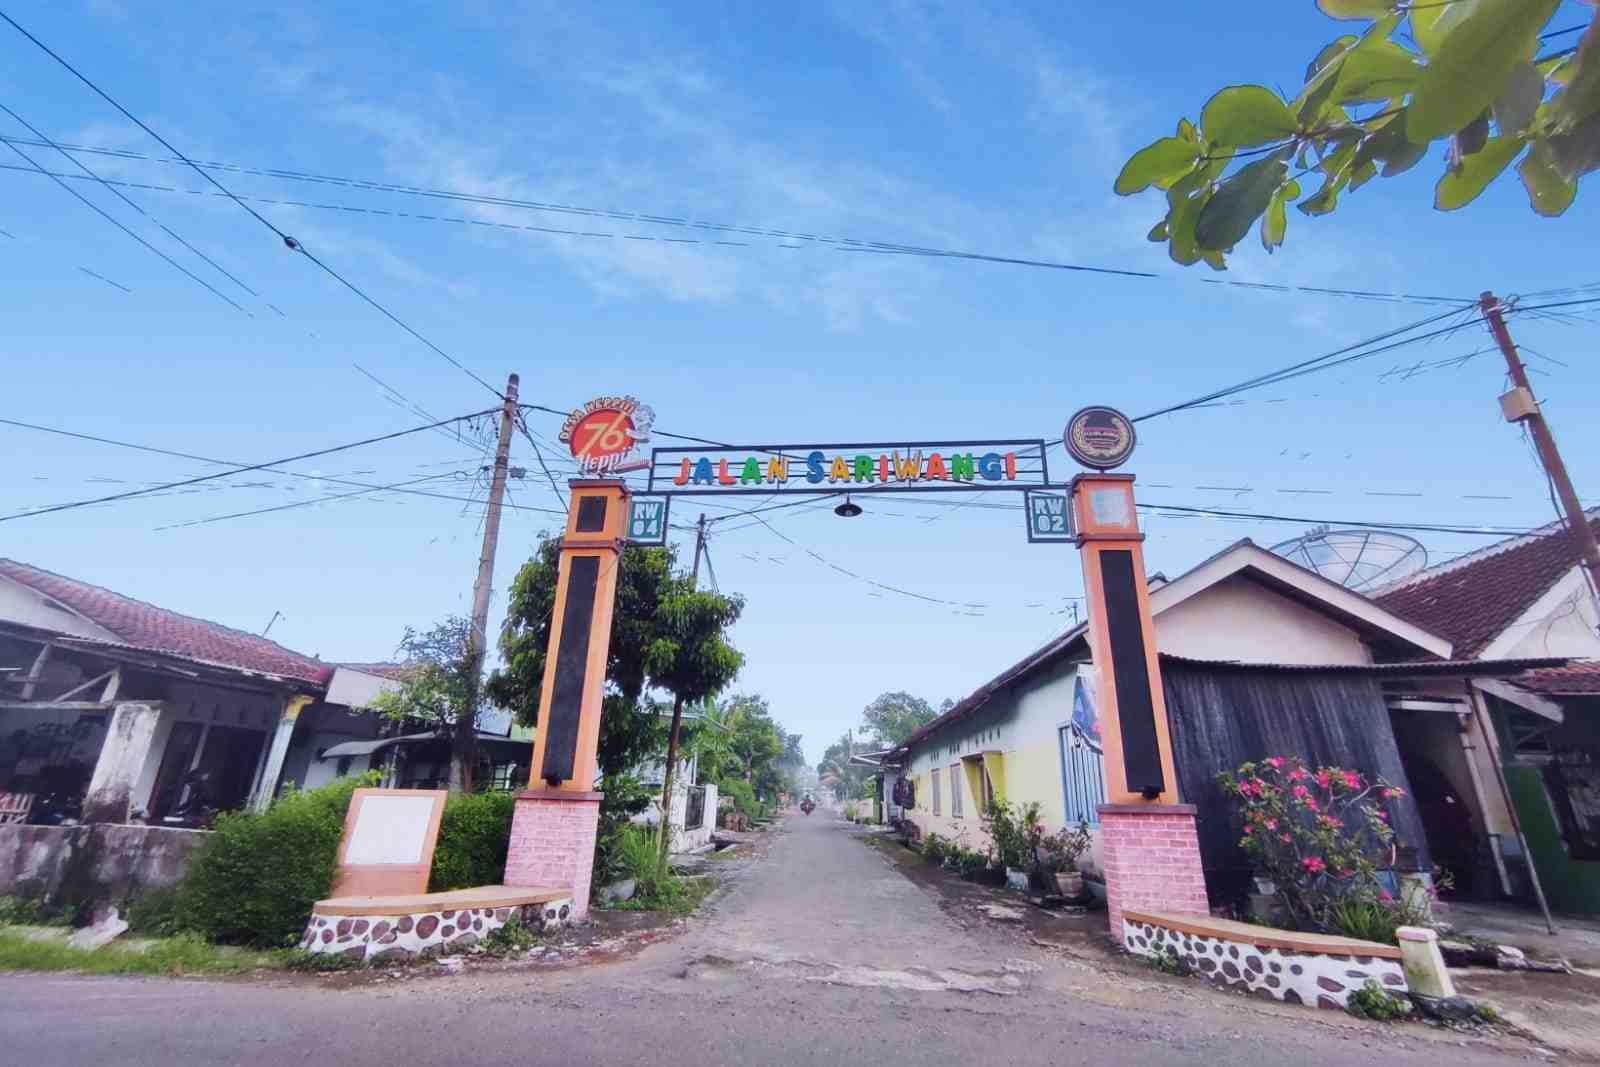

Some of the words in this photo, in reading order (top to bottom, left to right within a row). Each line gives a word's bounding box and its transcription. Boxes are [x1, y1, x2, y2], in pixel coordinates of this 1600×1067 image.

[577, 411, 626, 455] 76
[673, 457, 787, 485] JALAN
[806, 450, 1016, 483] SARIWANGI
[634, 503, 659, 519] RW
[1034, 498, 1063, 514] RW
[1038, 515, 1065, 532] 02
